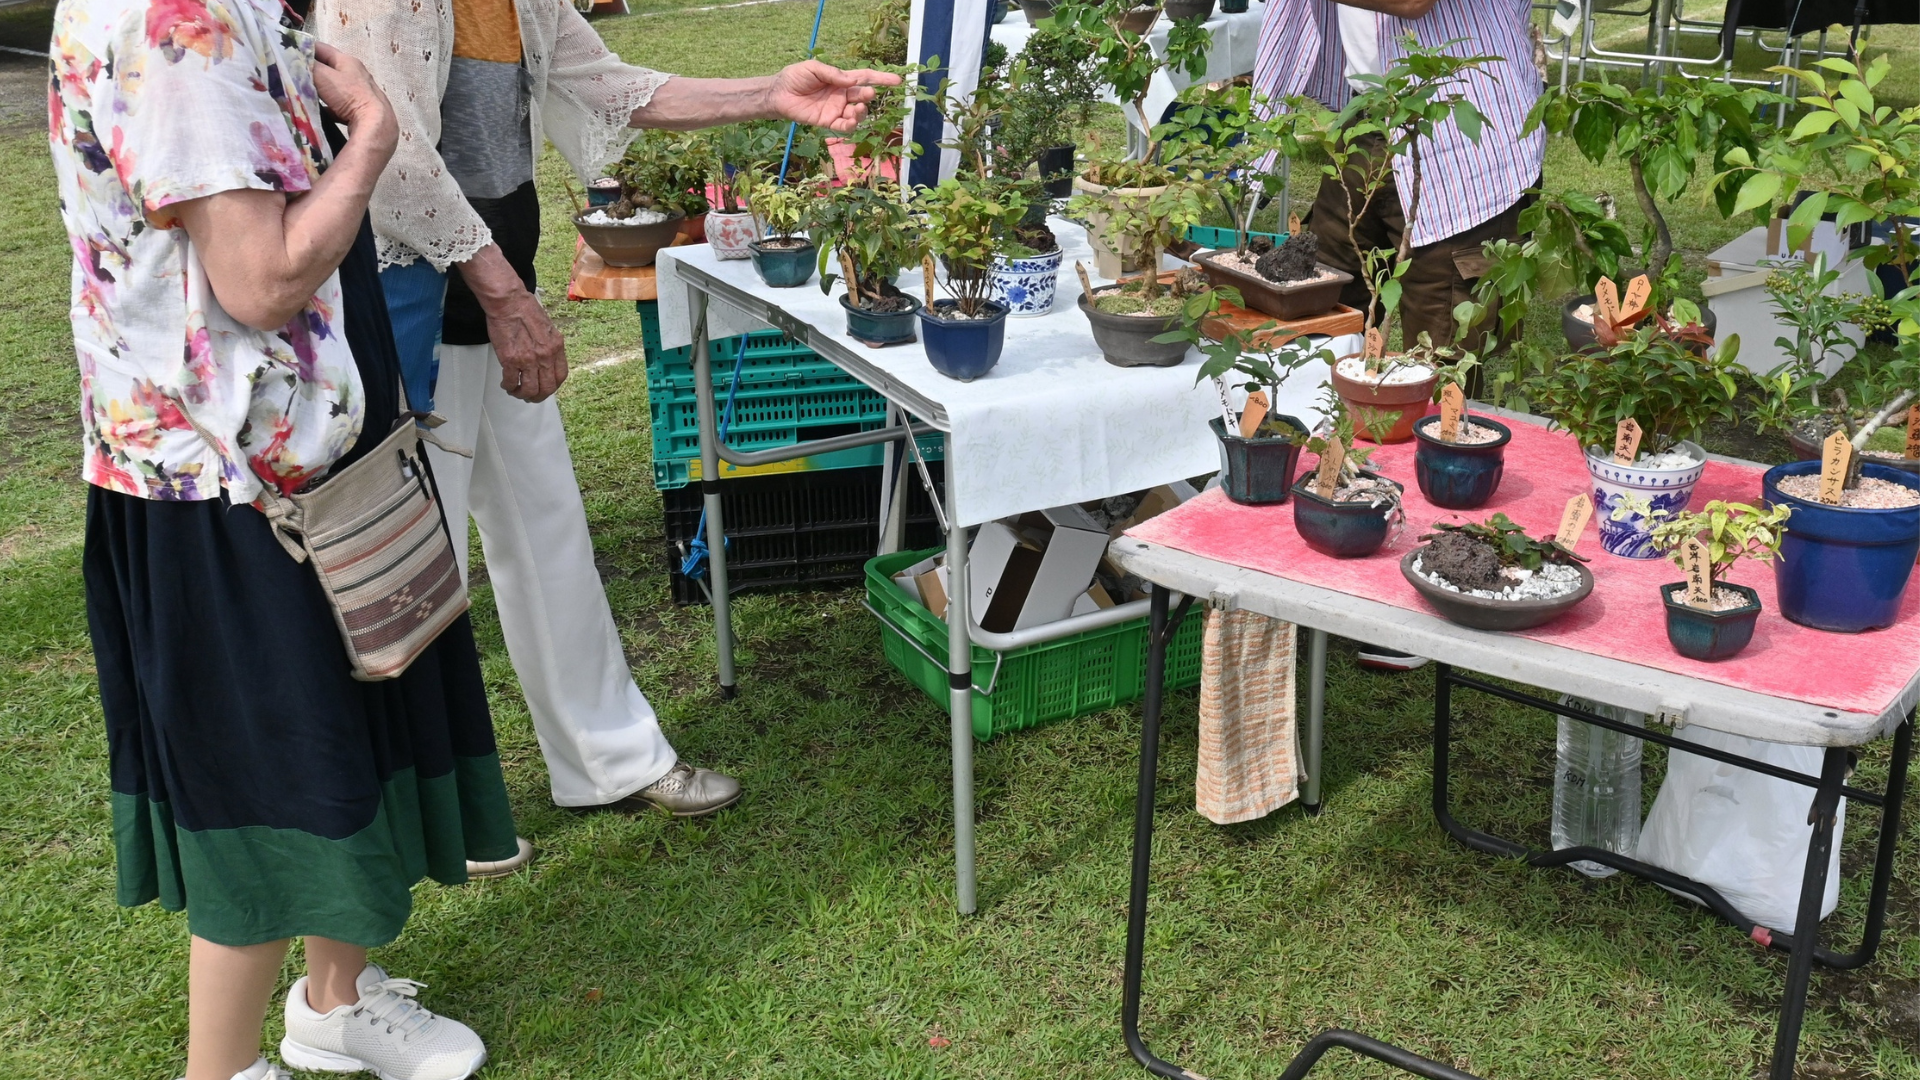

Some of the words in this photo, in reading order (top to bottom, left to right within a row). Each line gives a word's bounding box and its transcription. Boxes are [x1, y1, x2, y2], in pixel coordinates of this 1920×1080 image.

[1216, 377, 1236, 429] ウメモドキ
[1620, 421, 1635, 455] 岩南天
[1824, 436, 1845, 497] ピラカンサス
[1687, 543, 1706, 596] 西洋岩南天
[1563, 769, 1586, 787] KDM
